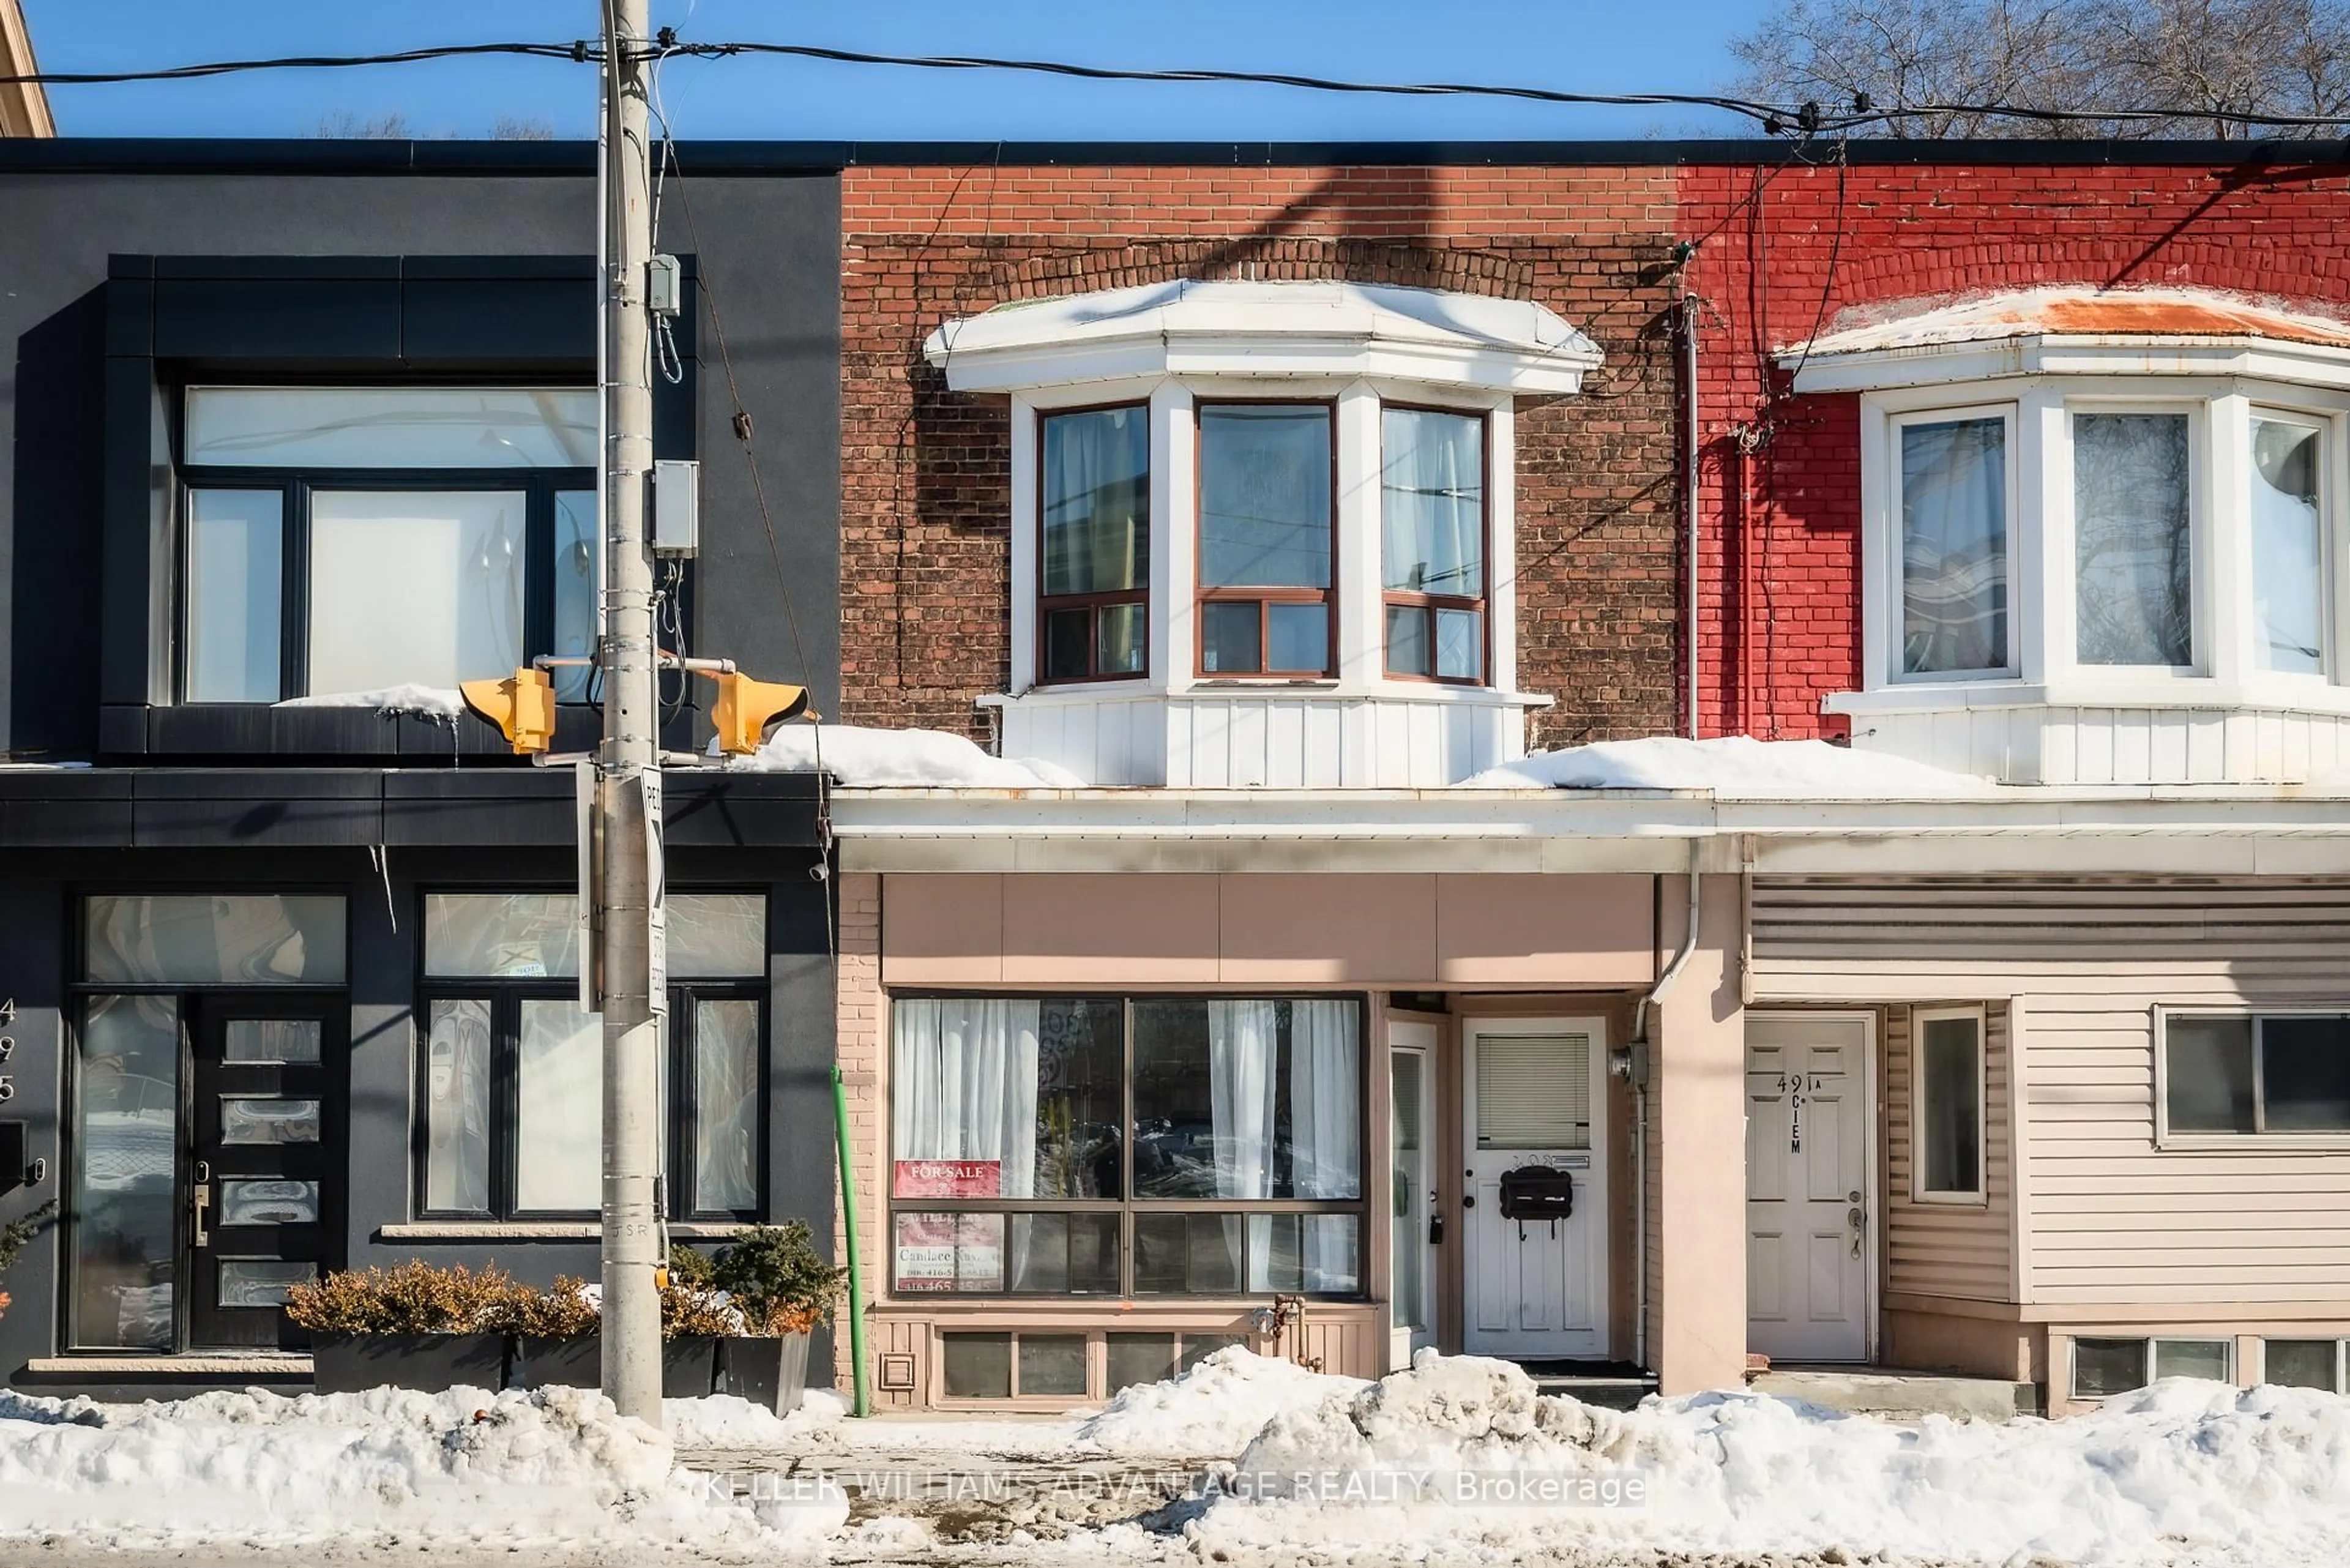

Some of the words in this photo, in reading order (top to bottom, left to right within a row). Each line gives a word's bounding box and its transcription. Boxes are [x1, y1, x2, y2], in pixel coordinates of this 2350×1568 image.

[1791, 1095, 1800, 1154] CIEM
[911, 1168, 941, 1178] FOR
[947, 1168, 984, 1178] SALE
[900, 1249, 951, 1262] Candace
